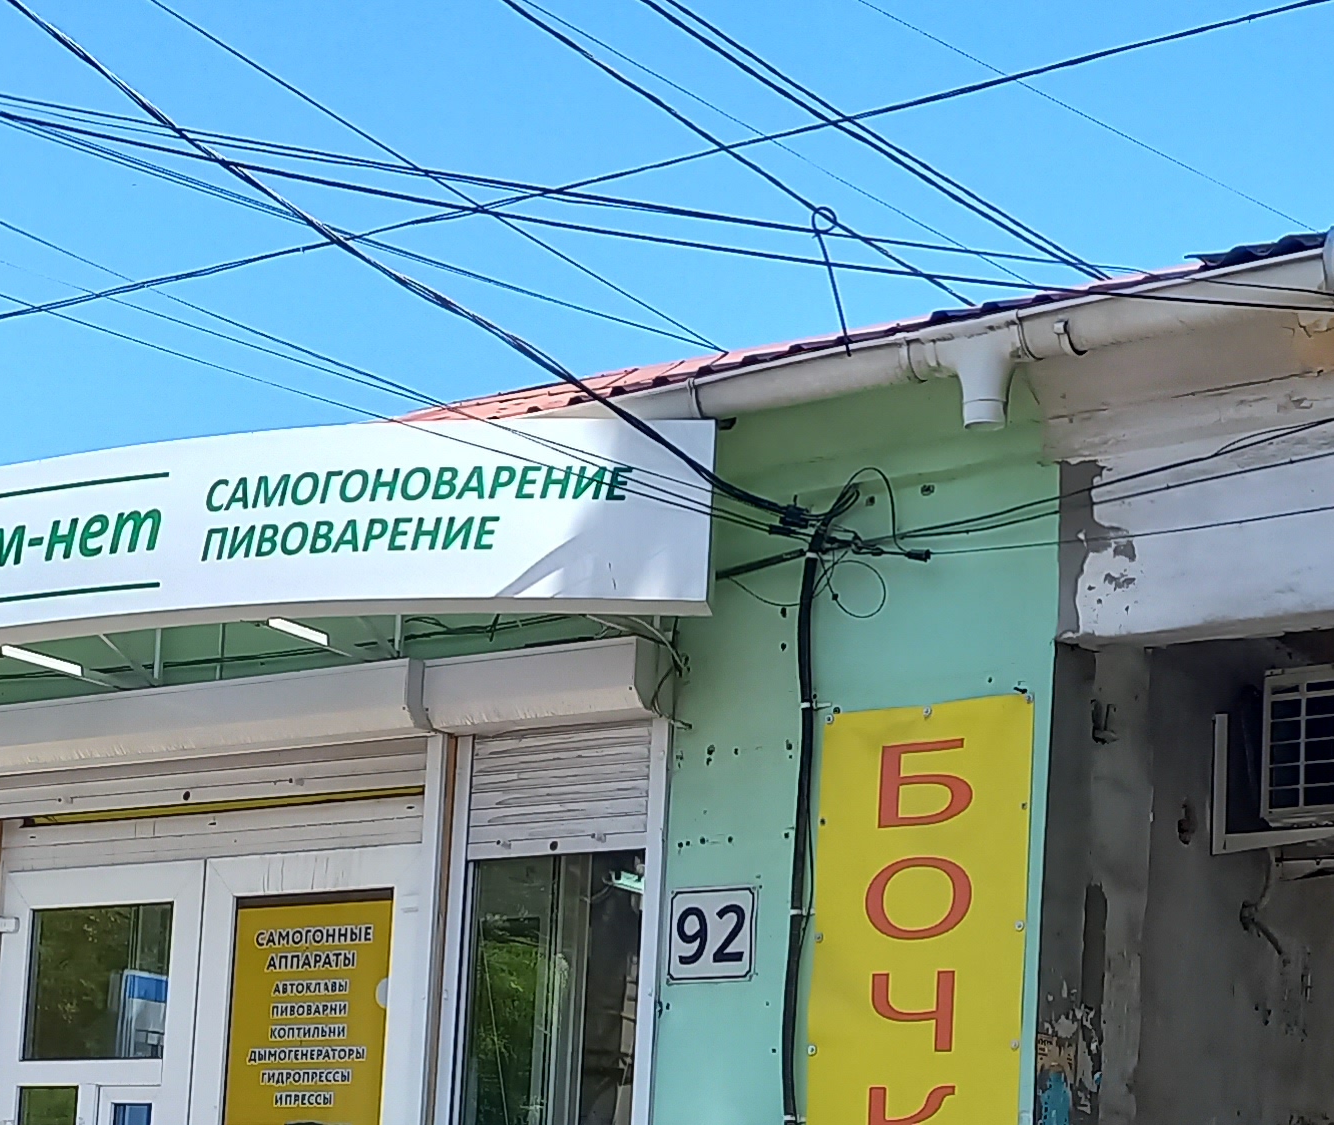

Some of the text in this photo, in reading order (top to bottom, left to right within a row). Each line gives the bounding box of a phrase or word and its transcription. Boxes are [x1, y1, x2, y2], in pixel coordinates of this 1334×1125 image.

[204, 465, 634, 512] САМОГОНОВАРЕНИЕ
[200, 515, 500, 562] ПИВОВАРЕНИЕ
[255, 926, 373, 947] САМОГОННЫЕ
[676, 903, 747, 965] 92
[266, 952, 356, 970] АППАРАТЫ
[272, 980, 348, 995] АВТОКЛАВЫ
[271, 1002, 347, 1018] ПИВОВАРНИ
[269, 1025, 346, 1040] КОПТИЛЬНИ
[247, 1047, 366, 1064] ДЫМОГЕНЕРАТОРЫ
[261, 1070, 350, 1085] ГИДРОПРЕССЫ
